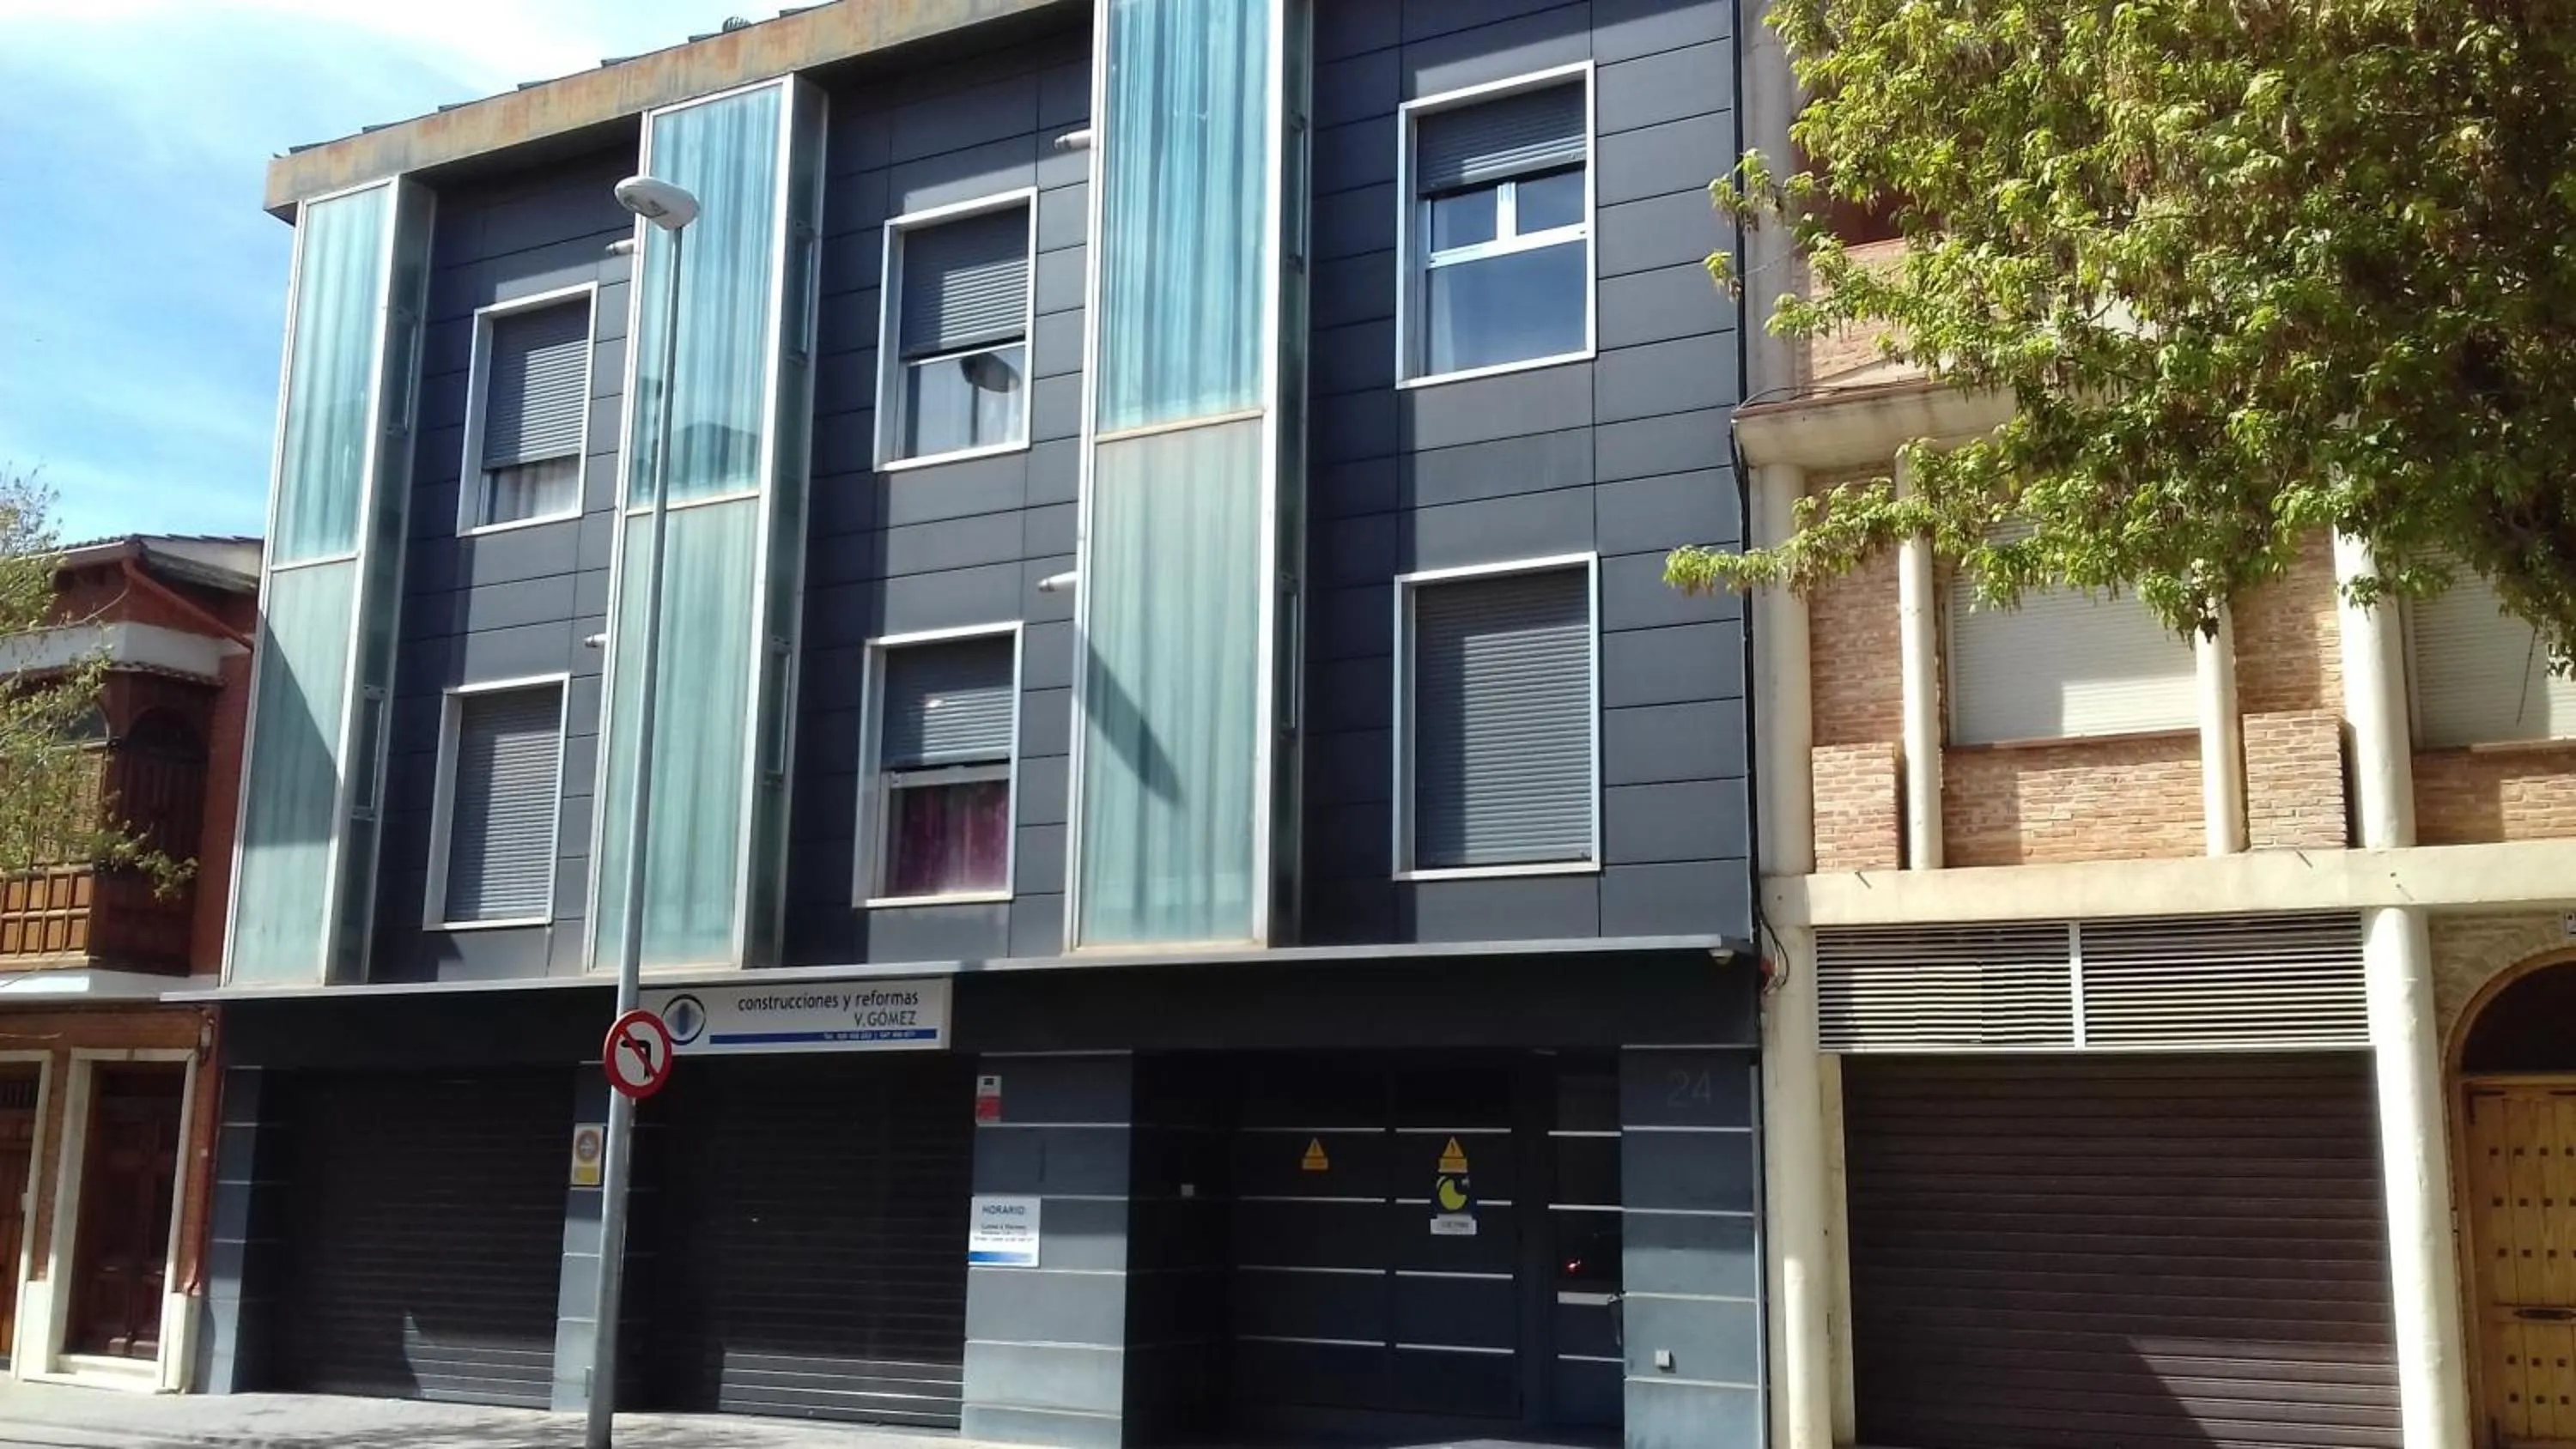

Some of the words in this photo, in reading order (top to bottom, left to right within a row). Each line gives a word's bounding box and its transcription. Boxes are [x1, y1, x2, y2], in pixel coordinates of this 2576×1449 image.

[738, 992, 839, 1011] construcciones
[843, 994, 851, 1012] y
[856, 990, 919, 1007] reformas
[1667, 1069, 1711, 1108] 24
